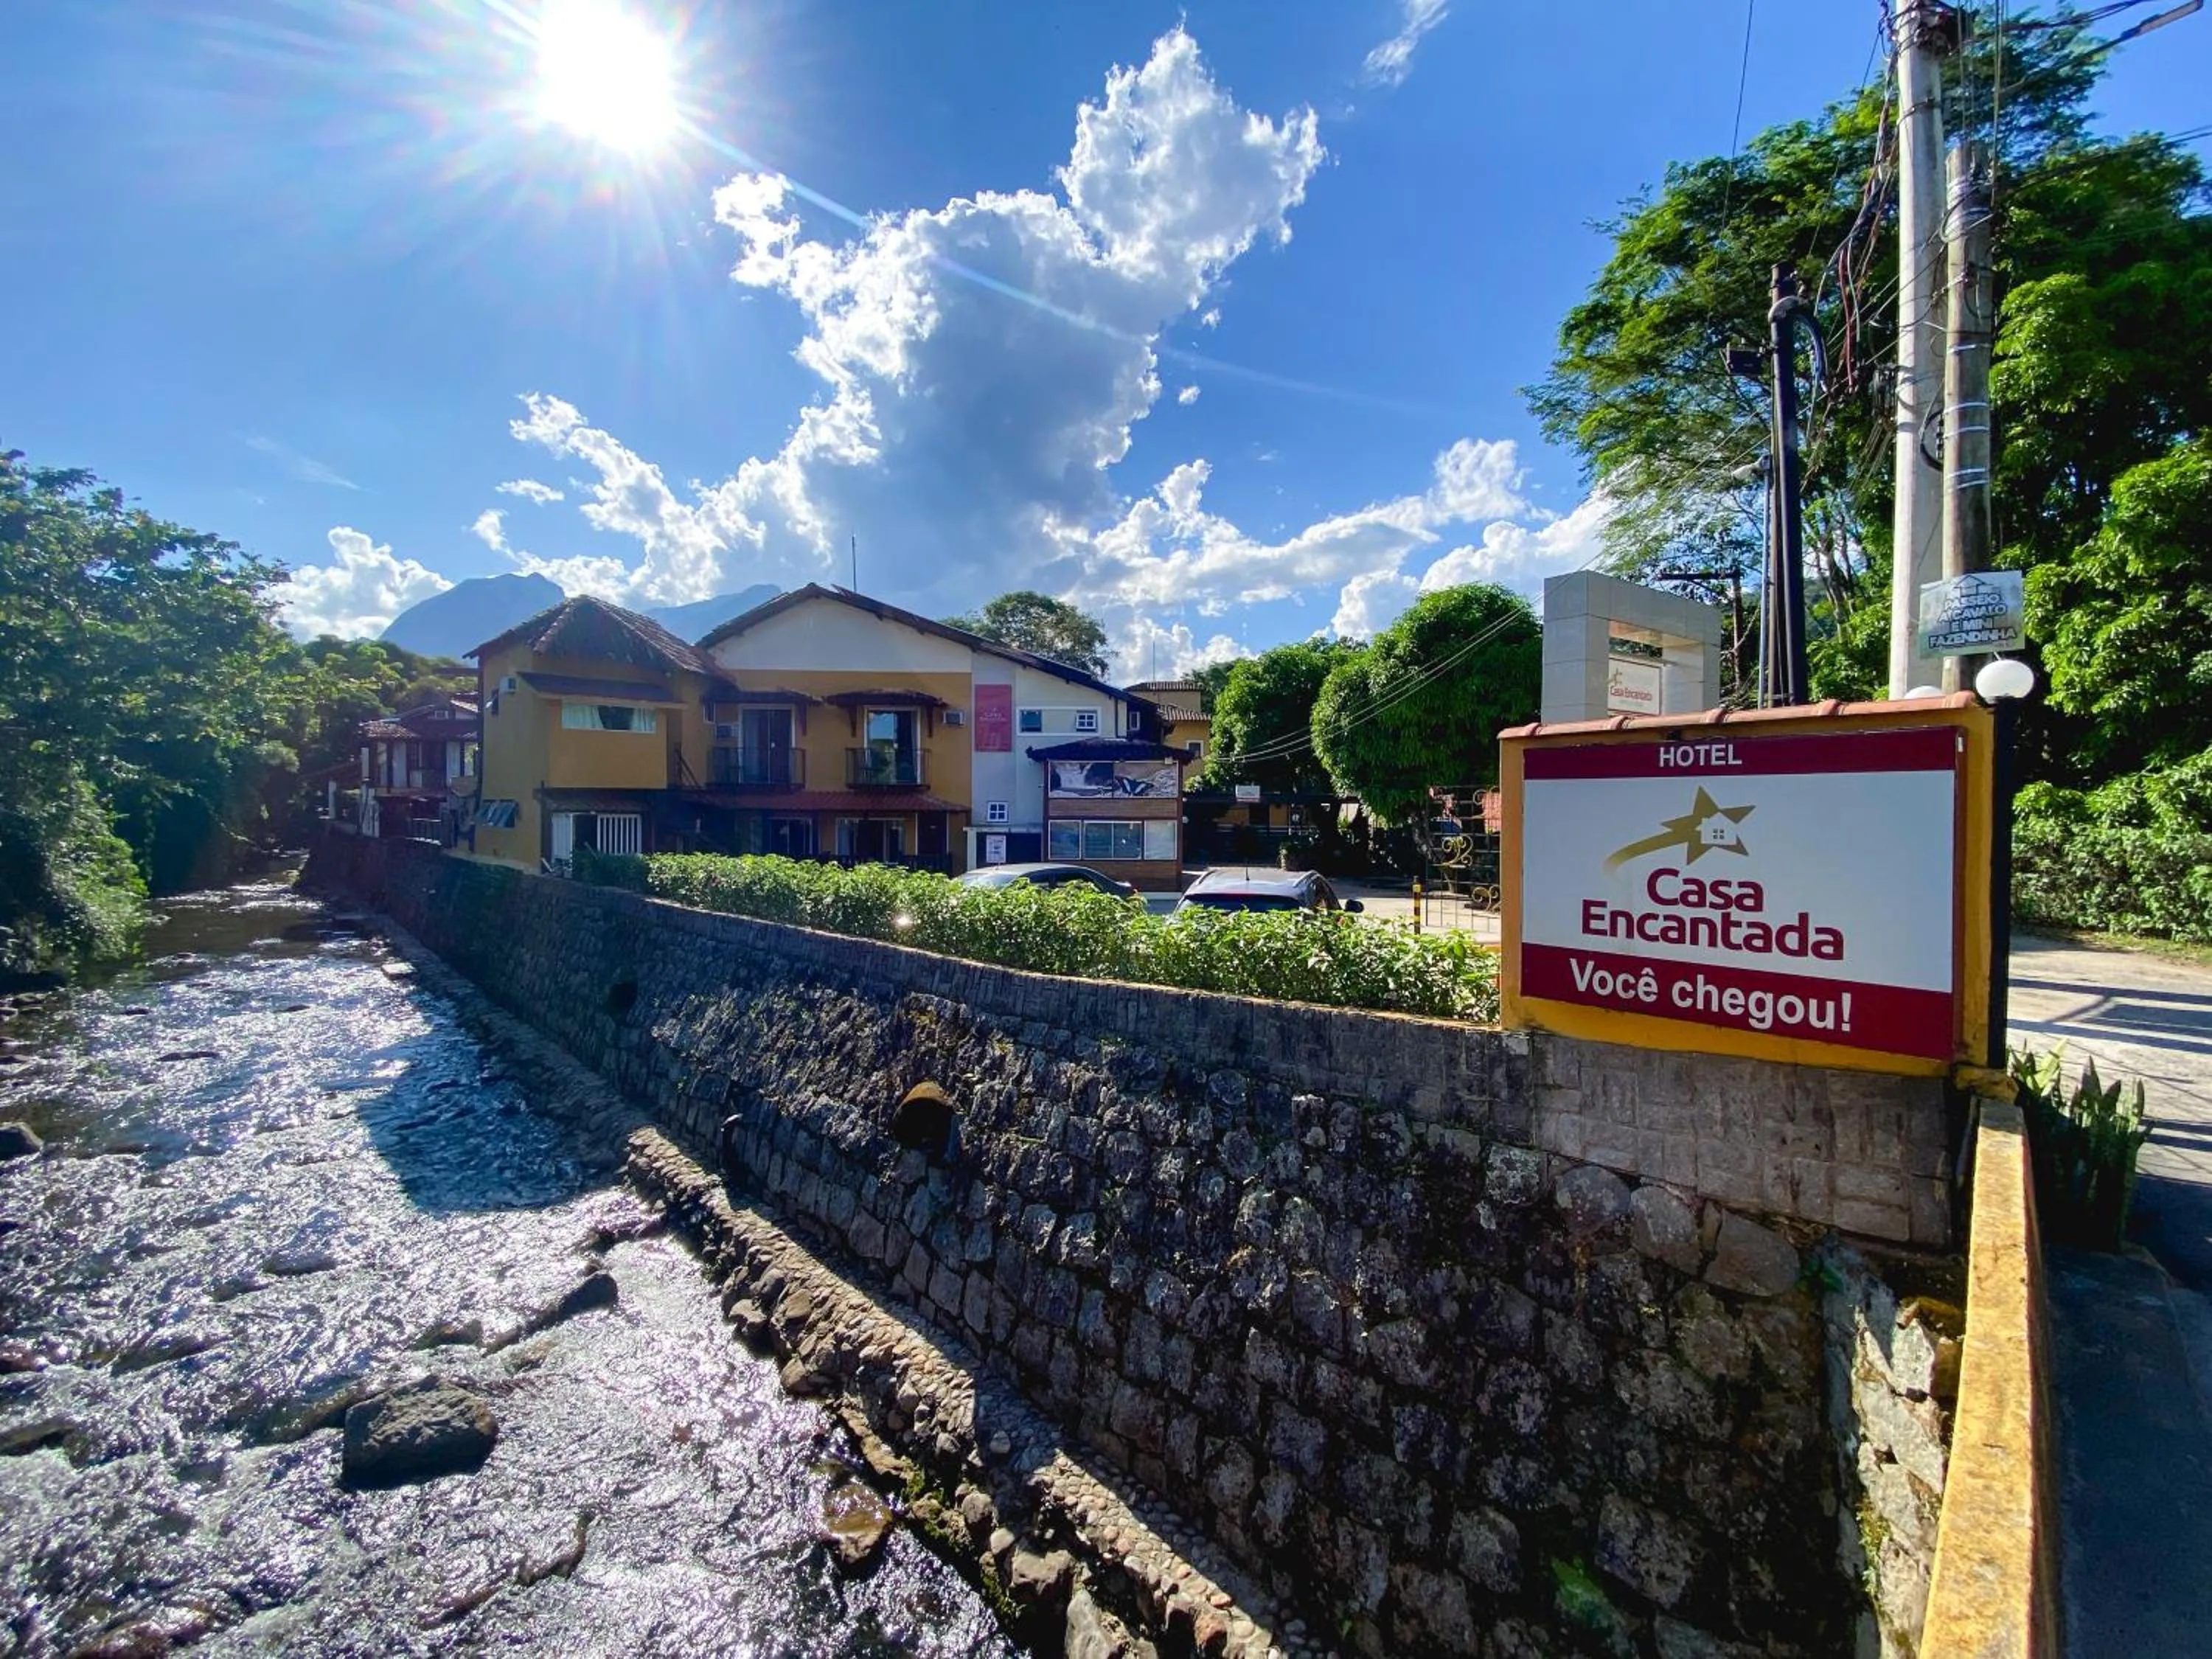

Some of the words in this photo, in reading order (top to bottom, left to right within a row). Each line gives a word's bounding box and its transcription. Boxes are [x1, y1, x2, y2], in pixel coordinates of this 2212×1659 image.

[1945, 594, 2000, 609] PASSEIO
[1930, 628, 2016, 647] FAZENDINHA
[1952, 622, 1961, 631] E
[1660, 744, 1742, 768] HOTEL
[1647, 868, 1764, 913] Casa
[1582, 899, 1844, 961] Encantada
[1570, 958, 1658, 1003] Você
[1672, 974, 1851, 1032] chegou!
